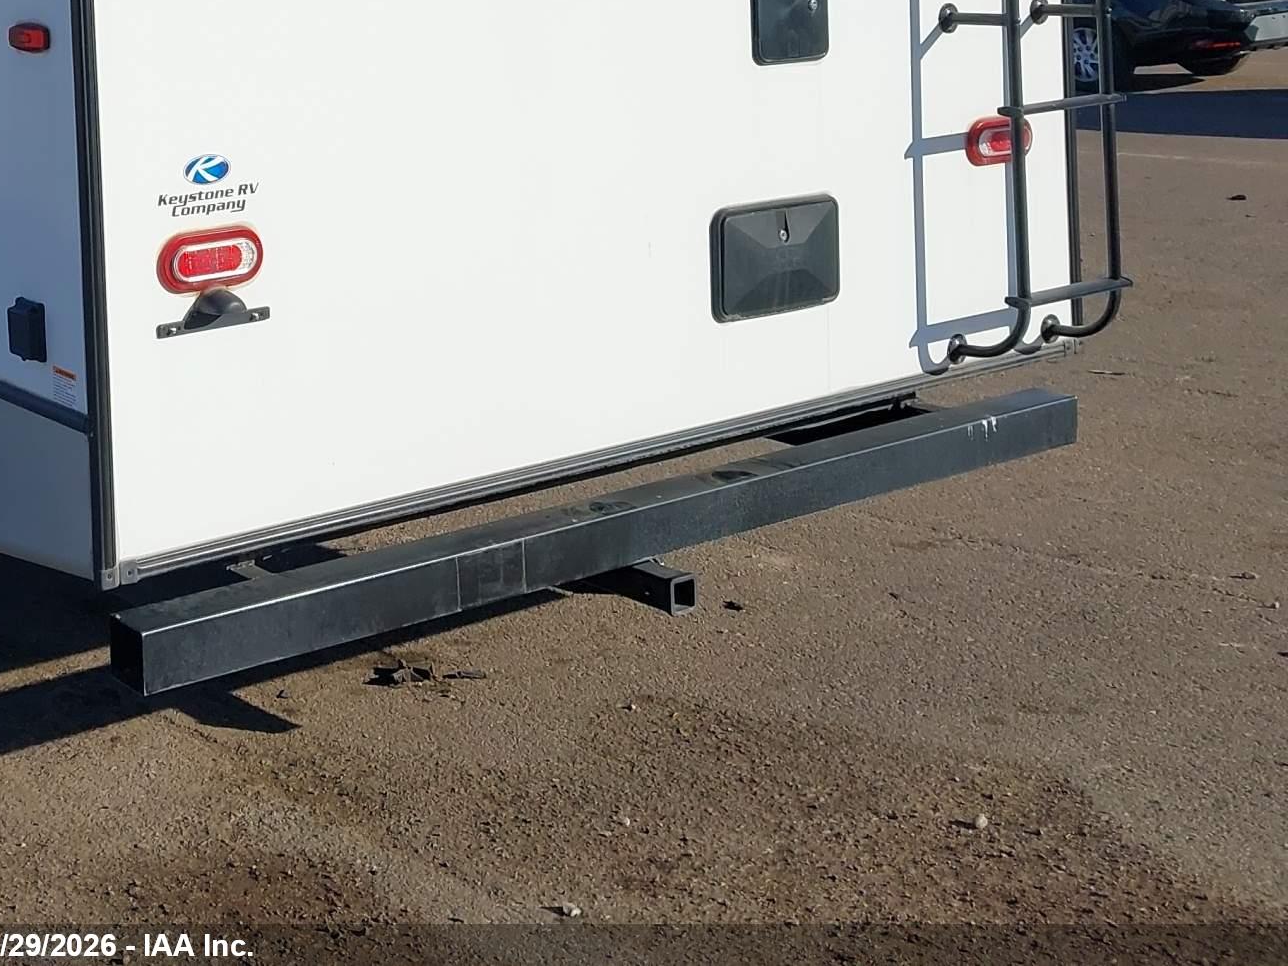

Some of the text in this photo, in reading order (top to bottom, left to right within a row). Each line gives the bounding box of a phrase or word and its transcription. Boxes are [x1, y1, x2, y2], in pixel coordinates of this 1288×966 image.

[157, 182, 259, 207] Keystone RV
[171, 199, 246, 218] Company
